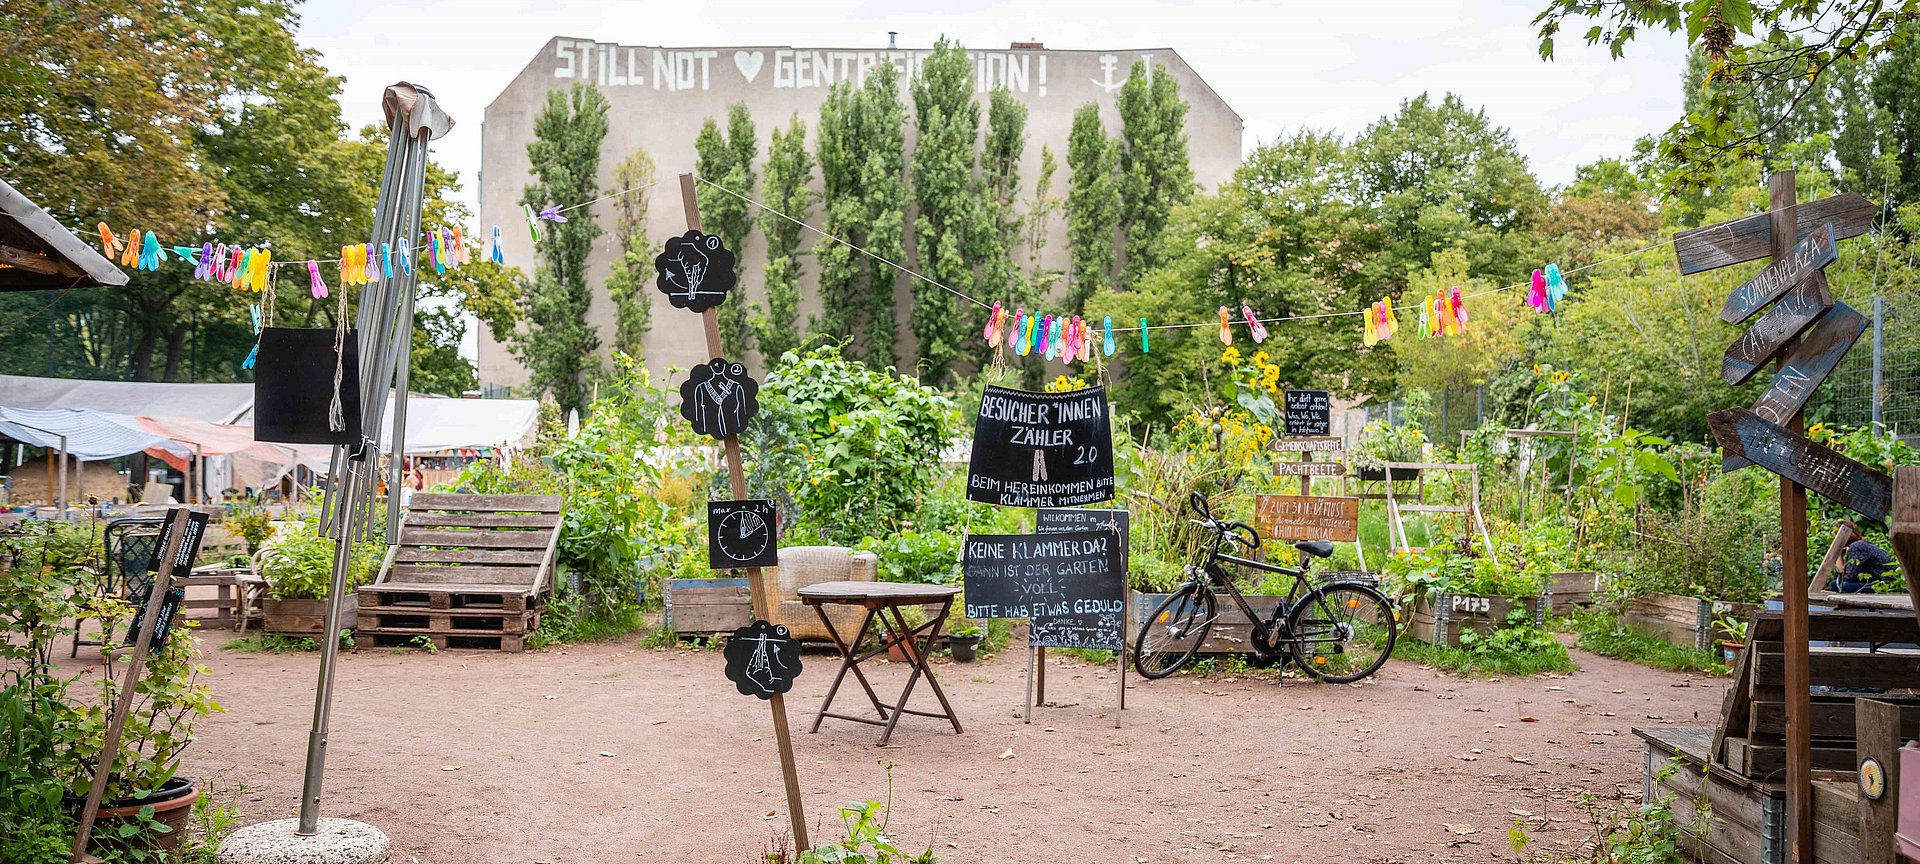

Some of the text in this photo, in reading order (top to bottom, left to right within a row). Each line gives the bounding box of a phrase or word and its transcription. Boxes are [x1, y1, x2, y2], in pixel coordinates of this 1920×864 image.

[652, 50, 718, 92] NOT
[1740, 237, 1822, 313] SONNENPLAZA
[1010, 425, 1074, 447] ZÄHLER
[1274, 439, 1341, 452] GEMEINSCHAFTSBEETE
[1073, 445, 1098, 465] 2.0
[1279, 463, 1337, 476] PACHTBEETE
[971, 474, 1113, 495] BEIM HEREINKOMMEN BITTE
[1000, 489, 1106, 507] KLAMMER MITNEHMEN
[712, 507, 731, 515] max
[1042, 513, 1087, 523] WILKOMMEN
[968, 537, 1108, 559] KEINE KLAMMER DA?
[1004, 564, 1021, 577] IST
[1024, 563, 1050, 577] DER
[1056, 559, 1109, 576] GARTEN
[1022, 582, 1058, 595] VOLL
[967, 599, 1123, 618] BITTE HAB ETWAS GEDULD
[1452, 595, 1490, 613] P175
[1053, 618, 1075, 626] DANKE
